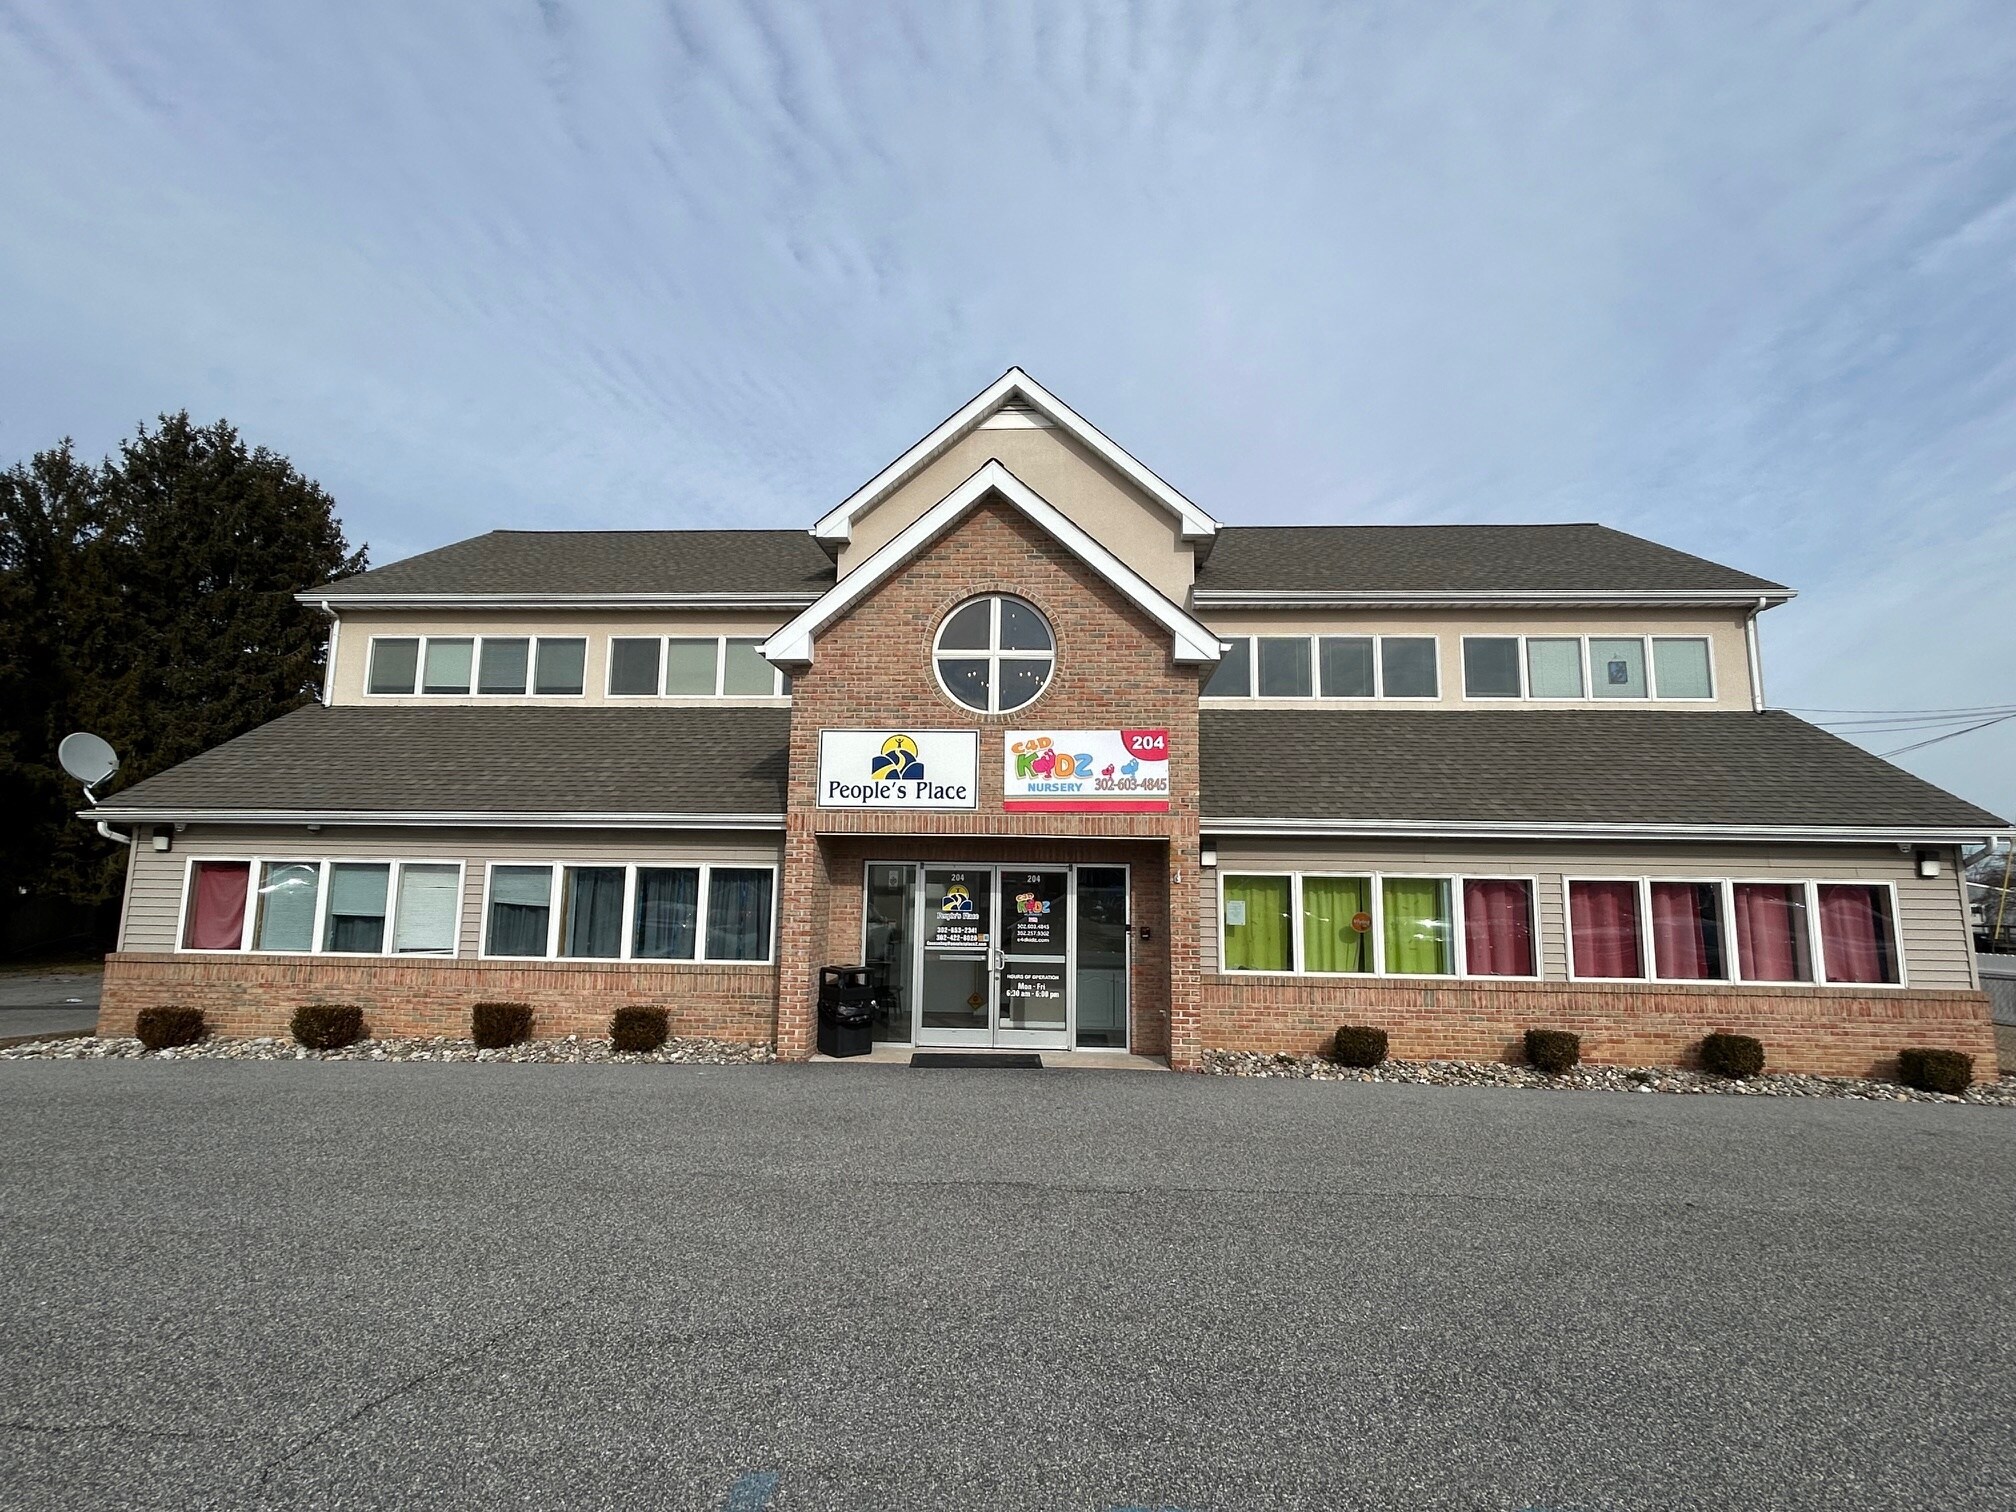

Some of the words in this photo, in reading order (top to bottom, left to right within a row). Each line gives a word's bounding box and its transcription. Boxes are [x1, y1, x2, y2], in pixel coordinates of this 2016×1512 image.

[1011, 736, 1052, 754] C4D
[1132, 736, 1164, 750] 204
[1028, 782, 1083, 792] NURSERY
[1094, 778, 1167, 791] 302-603-4845
[828, 781, 907, 803] People's
[916, 781, 967, 799] Place
[951, 873, 965, 881] 204
[1017, 982, 1032, 990] Mon
[1049, 992, 1060, 1000] pm
